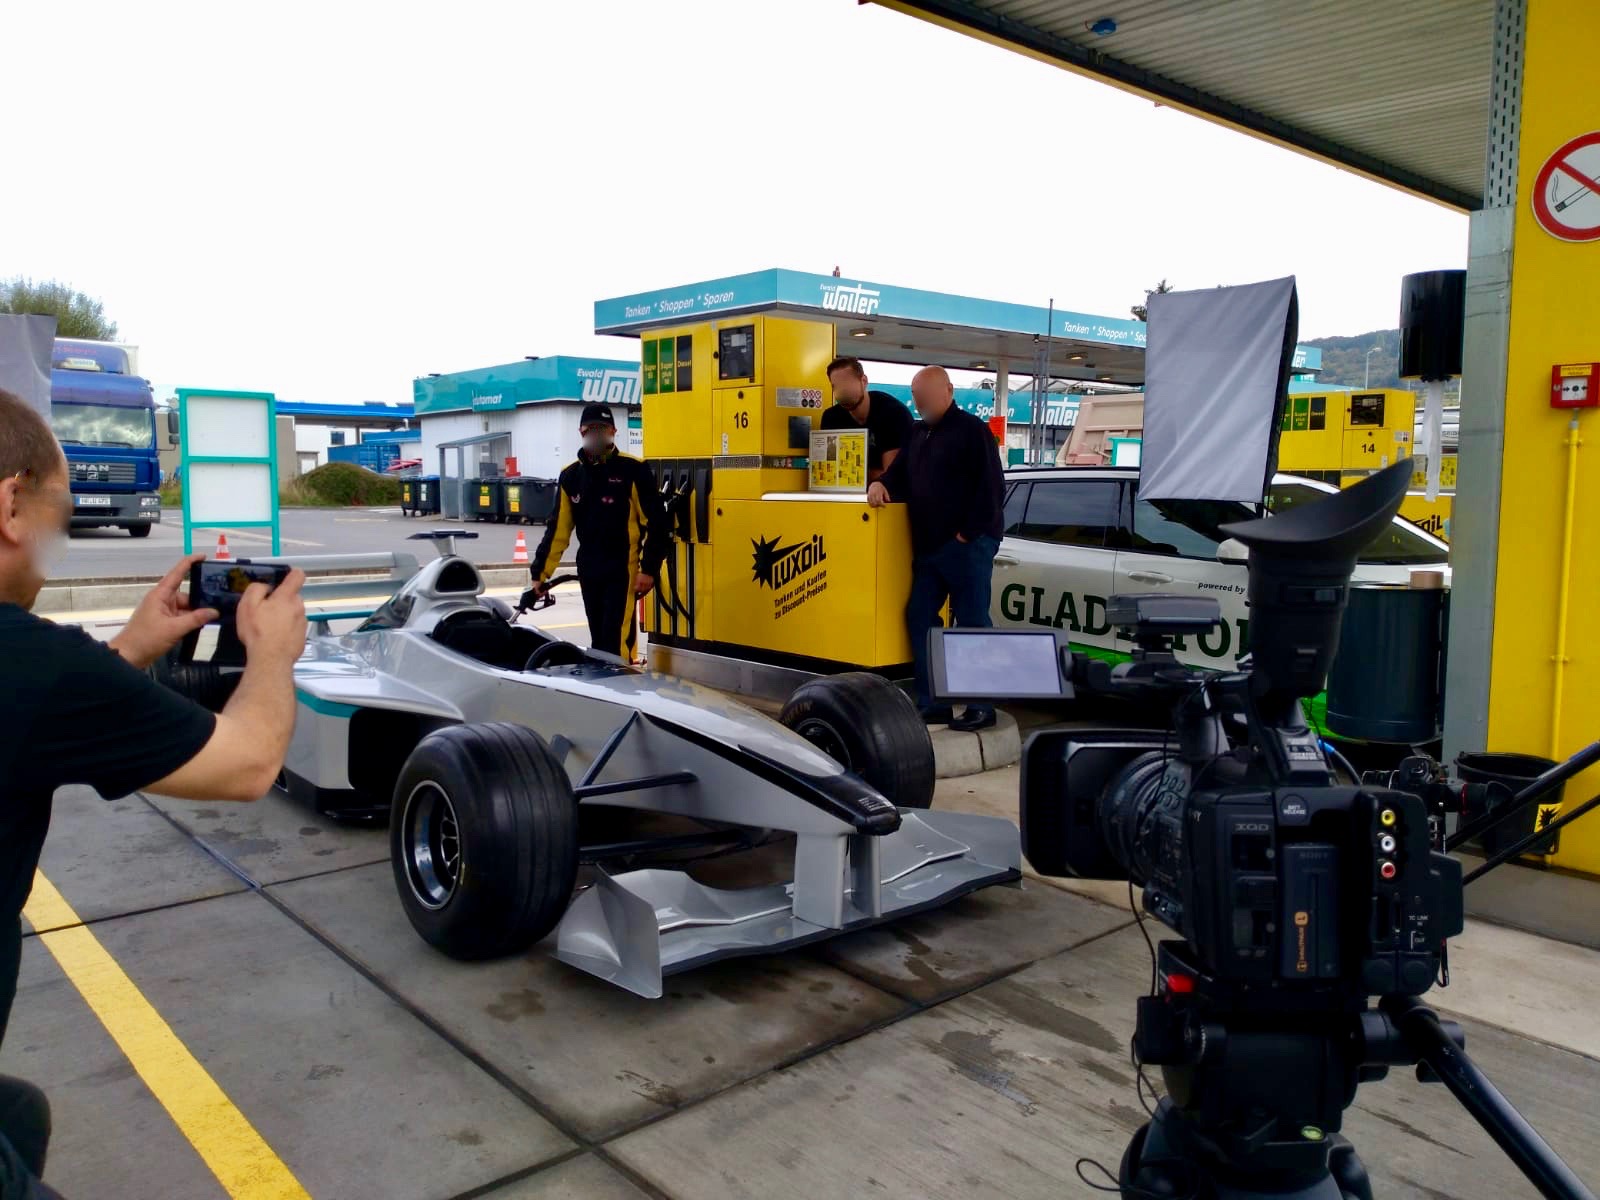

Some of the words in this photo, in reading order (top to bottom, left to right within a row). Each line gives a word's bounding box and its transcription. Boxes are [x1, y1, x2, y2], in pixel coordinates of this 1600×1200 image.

[625, 305, 651, 319] Tanken
[659, 297, 694, 314] Shoppen
[703, 290, 735, 308] Sparen
[1064, 321, 1090, 335] Tanken
[1097, 326, 1128, 341] Shoppen
[1135, 331, 1147, 344] Spa
[577, 367, 604, 378] Ewald
[582, 364, 642, 405] Wolt
[975, 403, 1015, 418] Span
[733, 411, 749, 430] 16
[1361, 443, 1376, 454] 14
[75, 464, 110, 472] MAN
[774, 591, 794, 609] Tanken
[794, 581, 806, 597] und
[806, 569, 827, 588] Kaufen
[1198, 582, 1233, 593] powered
[1235, 585, 1246, 595] by
